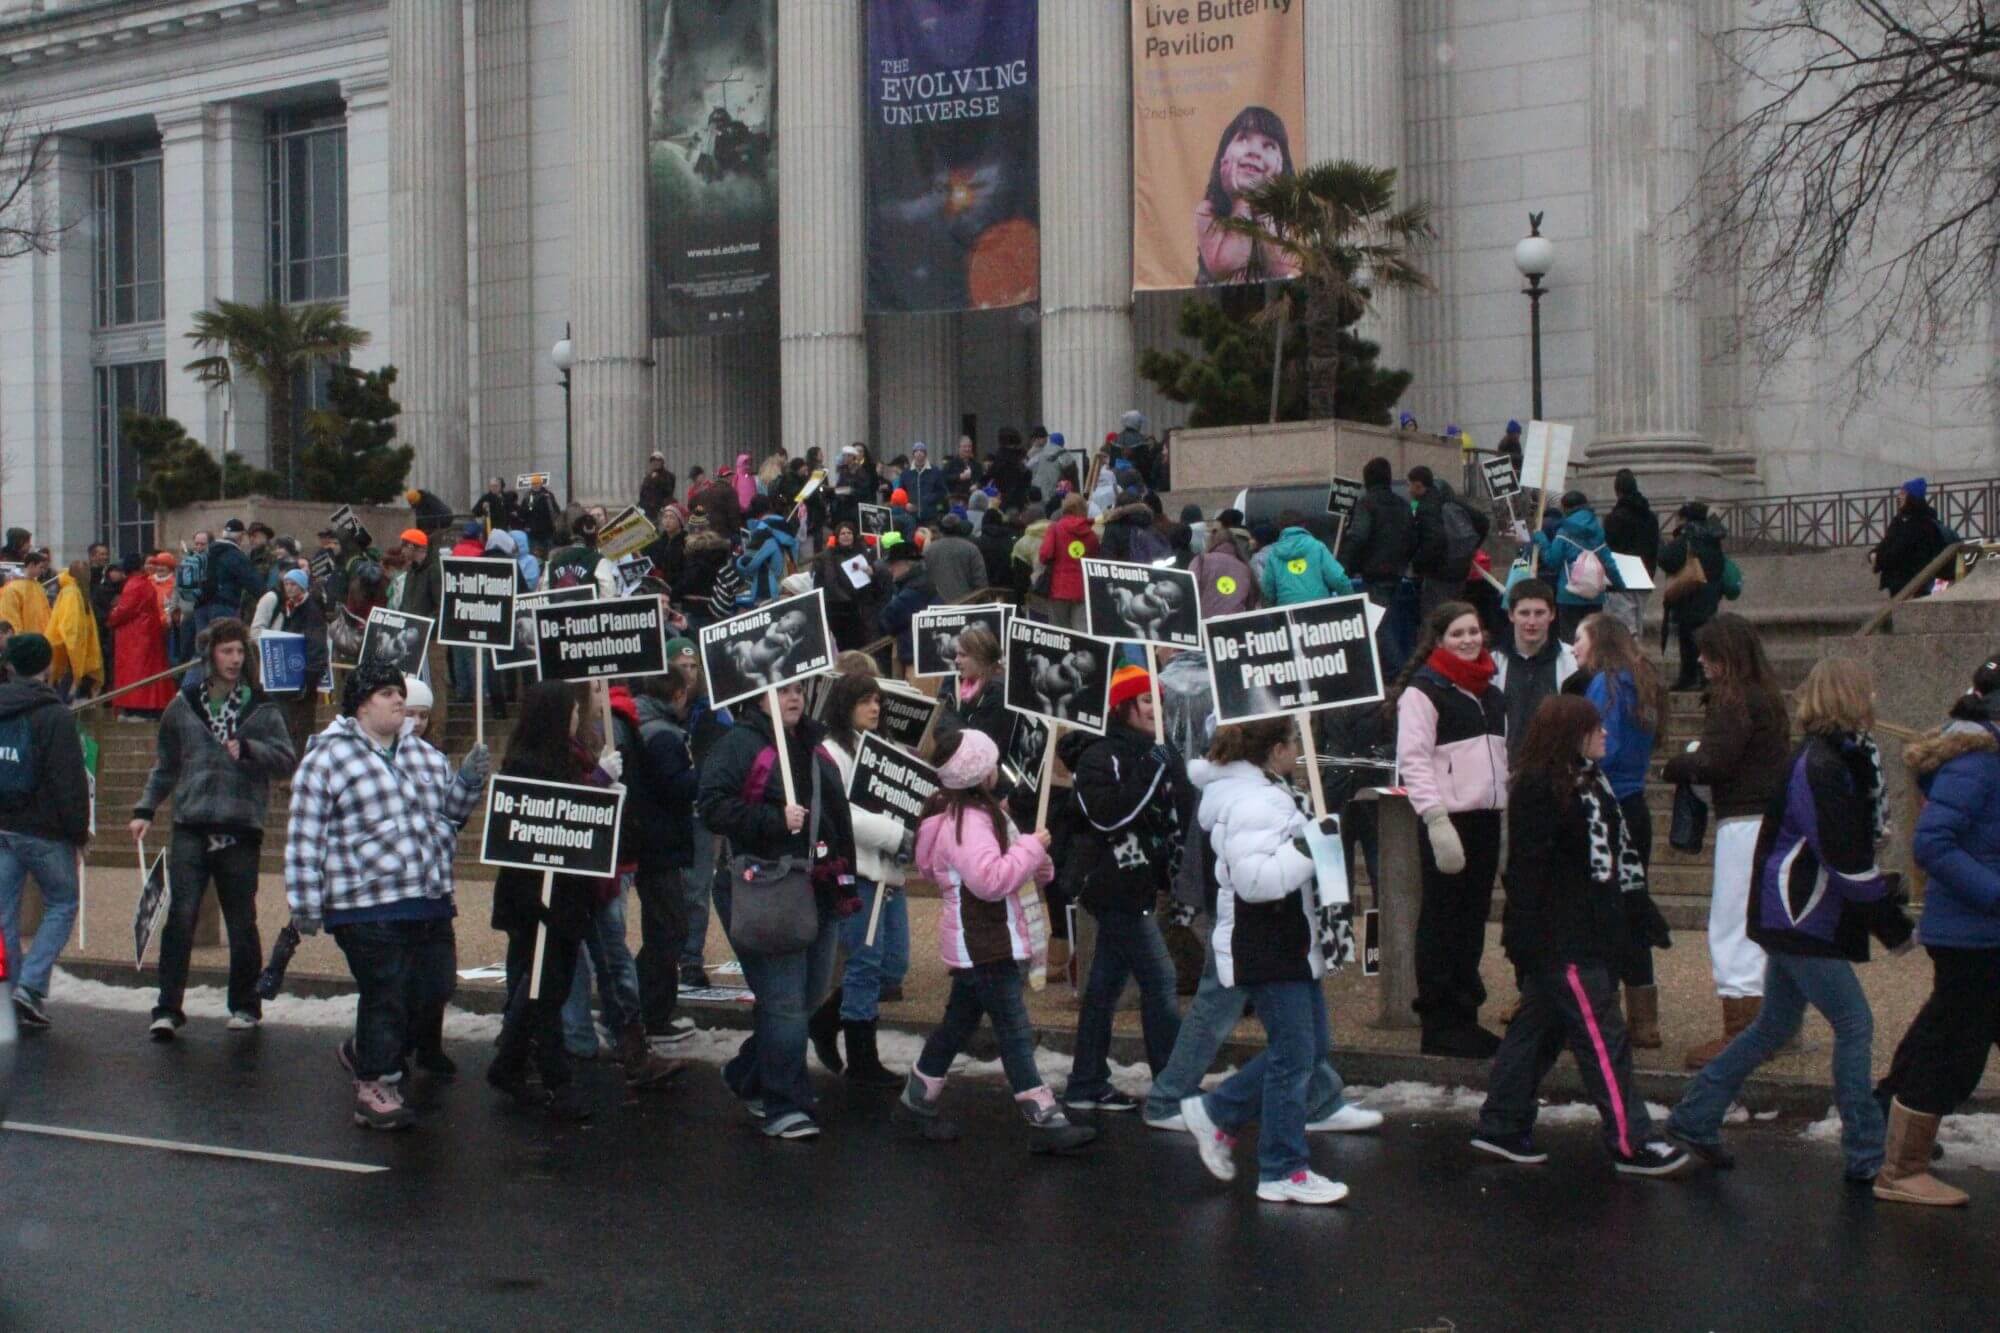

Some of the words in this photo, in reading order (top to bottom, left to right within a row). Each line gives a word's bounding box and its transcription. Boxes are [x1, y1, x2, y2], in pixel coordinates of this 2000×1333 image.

[1145, 3, 1190, 29] Live
[1145, 31, 1235, 59] Pavilion
[881, 58, 909, 74] THE
[881, 60, 1027, 102] EVOLVING
[882, 95, 1000, 125] UNIVERSE
[554, 564, 587, 578] TRITY
[1087, 562, 1109, 578] Life
[1109, 565, 1149, 583] Counts
[540, 614, 598, 639] De-Fund
[599, 608, 657, 633] Planned
[705, 628, 728, 644] Life
[729, 612, 772, 637] Counts
[919, 617, 936, 629] Life
[935, 615, 966, 627] Counts
[1011, 623, 1032, 643] Life
[1032, 627, 1072, 651] Counts
[559, 634, 642, 661] Parenthood
[1212, 626, 1290, 662] De-Fund
[1290, 613, 1366, 649] Planned
[1240, 648, 1348, 690] Parenthood
[860, 746, 906, 784] De-Fund
[903, 768, 940, 798] Plann
[493, 791, 556, 820] De-Fund
[556, 798, 615, 826] Planned
[867, 774, 923, 817] Parenthoo
[508, 819, 594, 850] Parenthood
